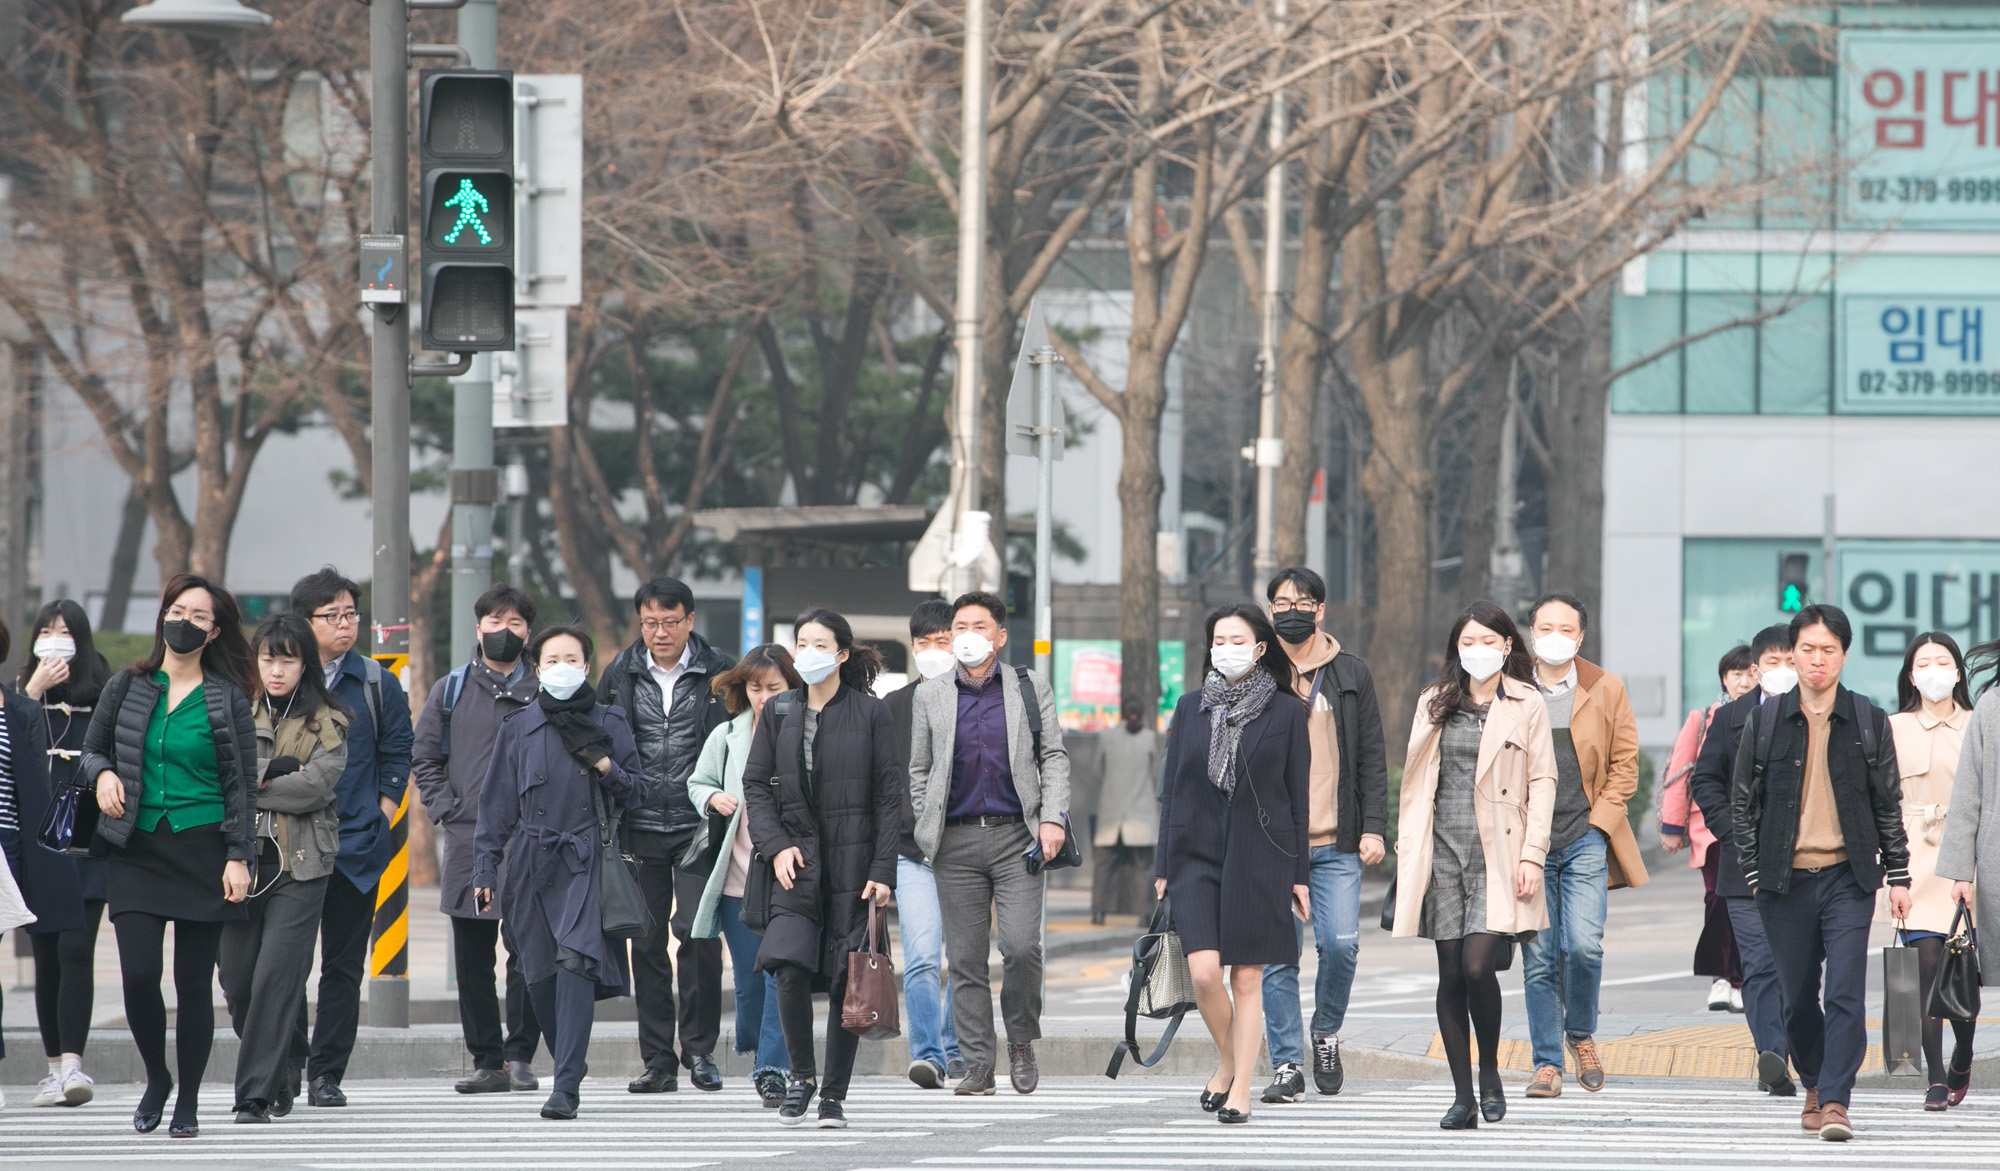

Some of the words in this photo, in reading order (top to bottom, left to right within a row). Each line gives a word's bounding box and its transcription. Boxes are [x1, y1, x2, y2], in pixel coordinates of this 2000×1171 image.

[1863, 70, 2000, 148] 임대
[1881, 306, 1982, 363] 임대
[1859, 371, 2000, 394] 02-379-9999
[1849, 571, 2000, 656] 임대
